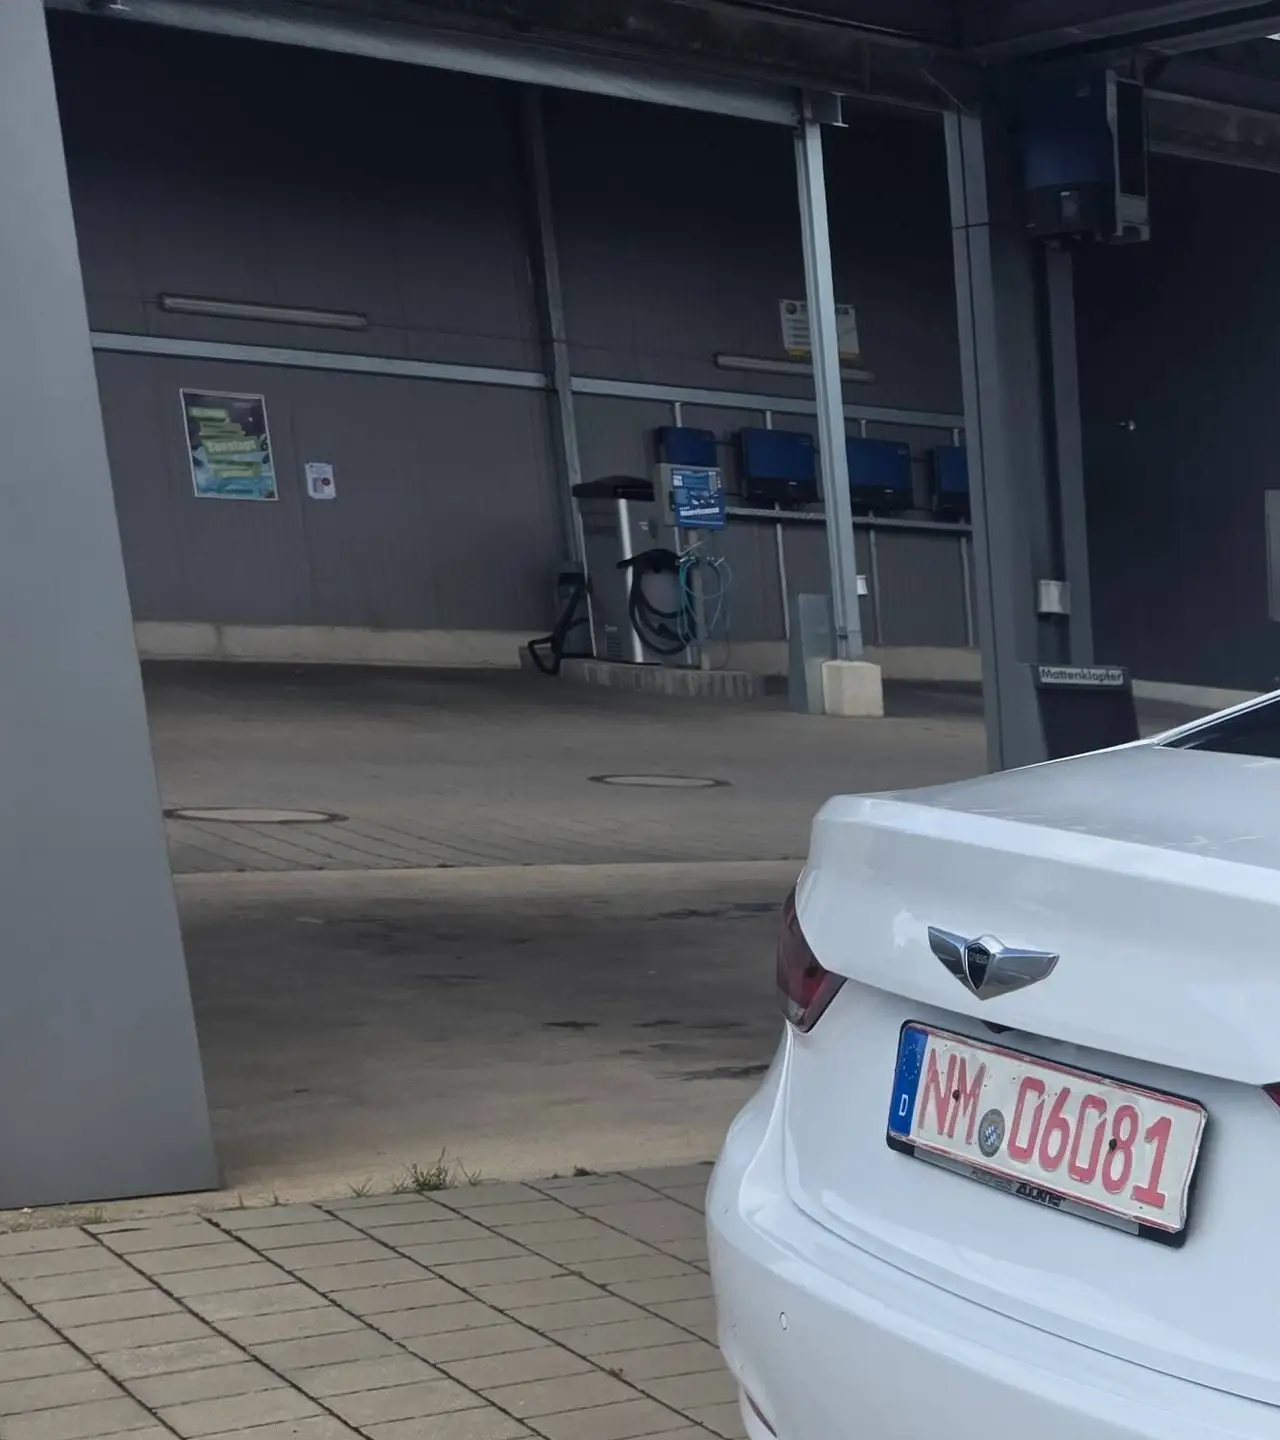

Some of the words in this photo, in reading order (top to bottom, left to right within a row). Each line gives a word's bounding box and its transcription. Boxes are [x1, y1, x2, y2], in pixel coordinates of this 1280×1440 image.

[898, 1093, 909, 1117] D
[918, 1048, 987, 1145] NM
[1006, 1075, 1173, 1209] 06081
